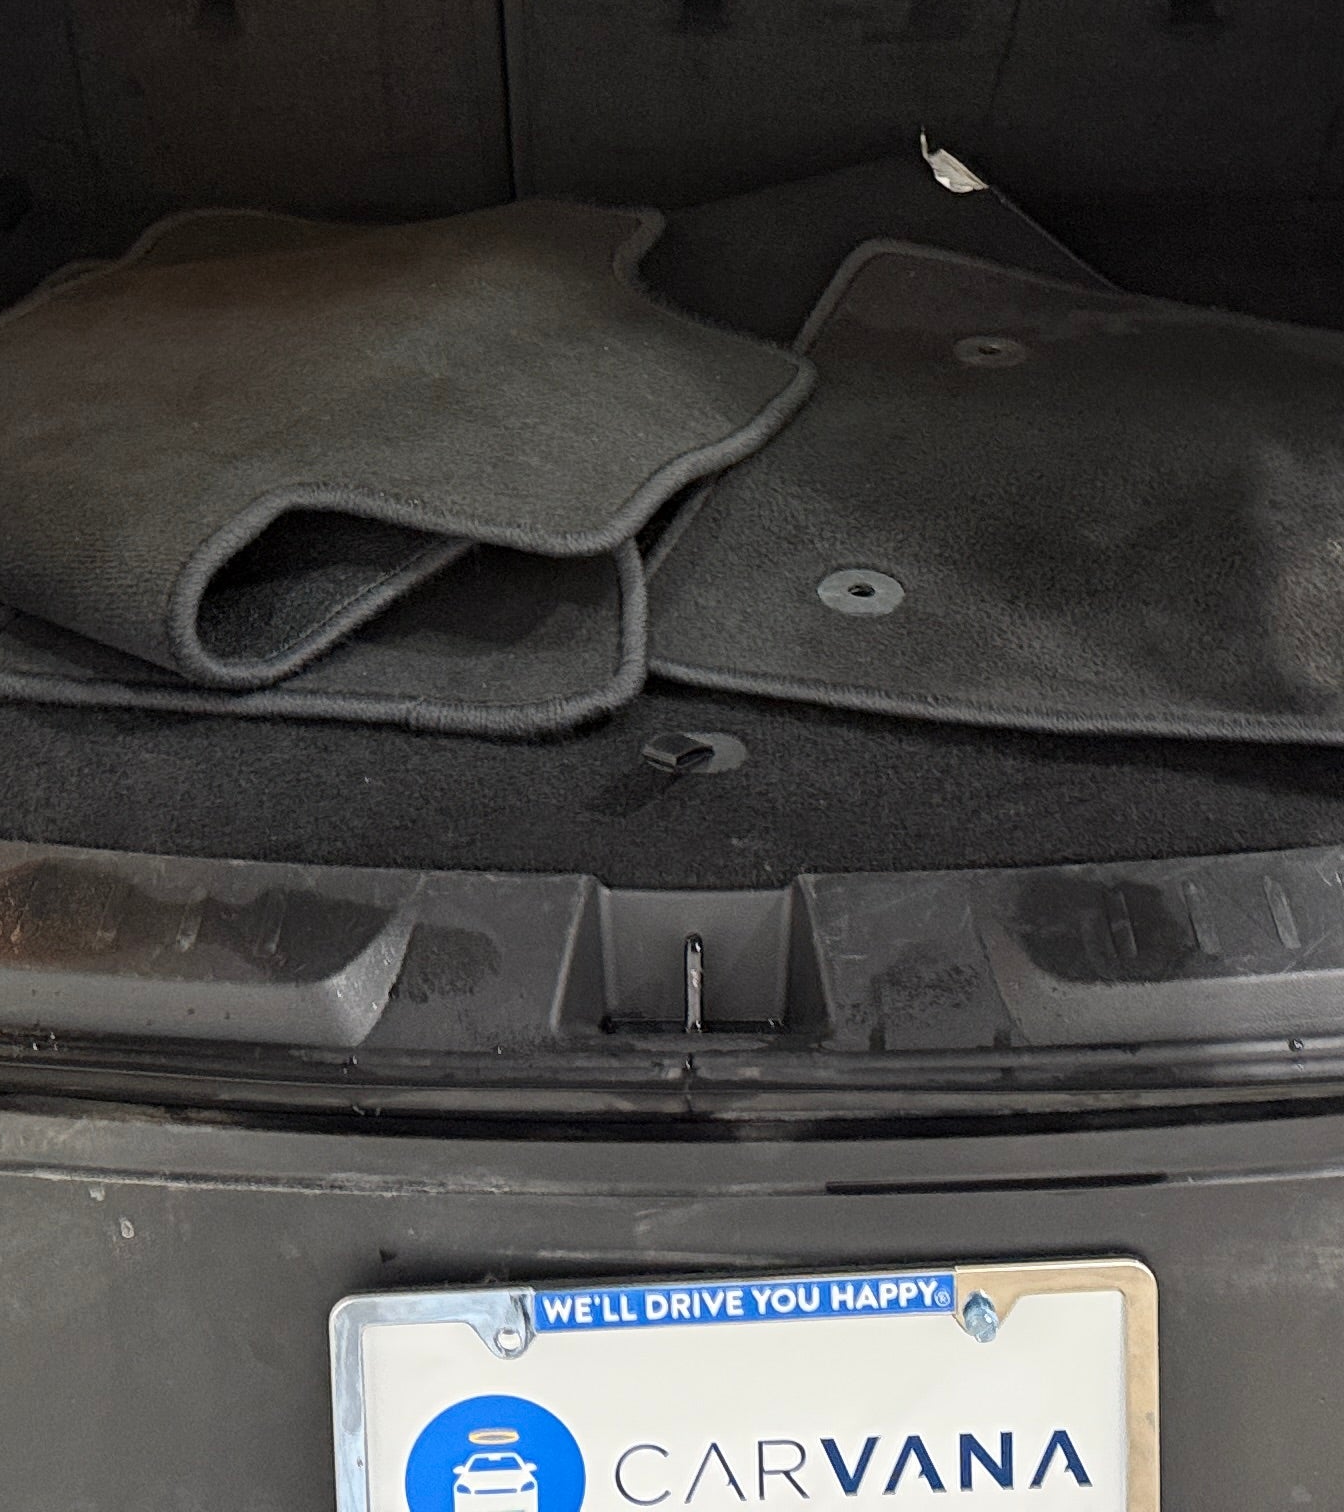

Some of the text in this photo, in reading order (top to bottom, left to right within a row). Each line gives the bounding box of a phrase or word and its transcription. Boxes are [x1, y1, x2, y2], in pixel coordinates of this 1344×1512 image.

[542, 1292, 638, 1325] WE'LL
[645, 1287, 745, 1321] DRIVE
[751, 1284, 821, 1315] YOU
[614, 1428, 1094, 1507] CARVANA
